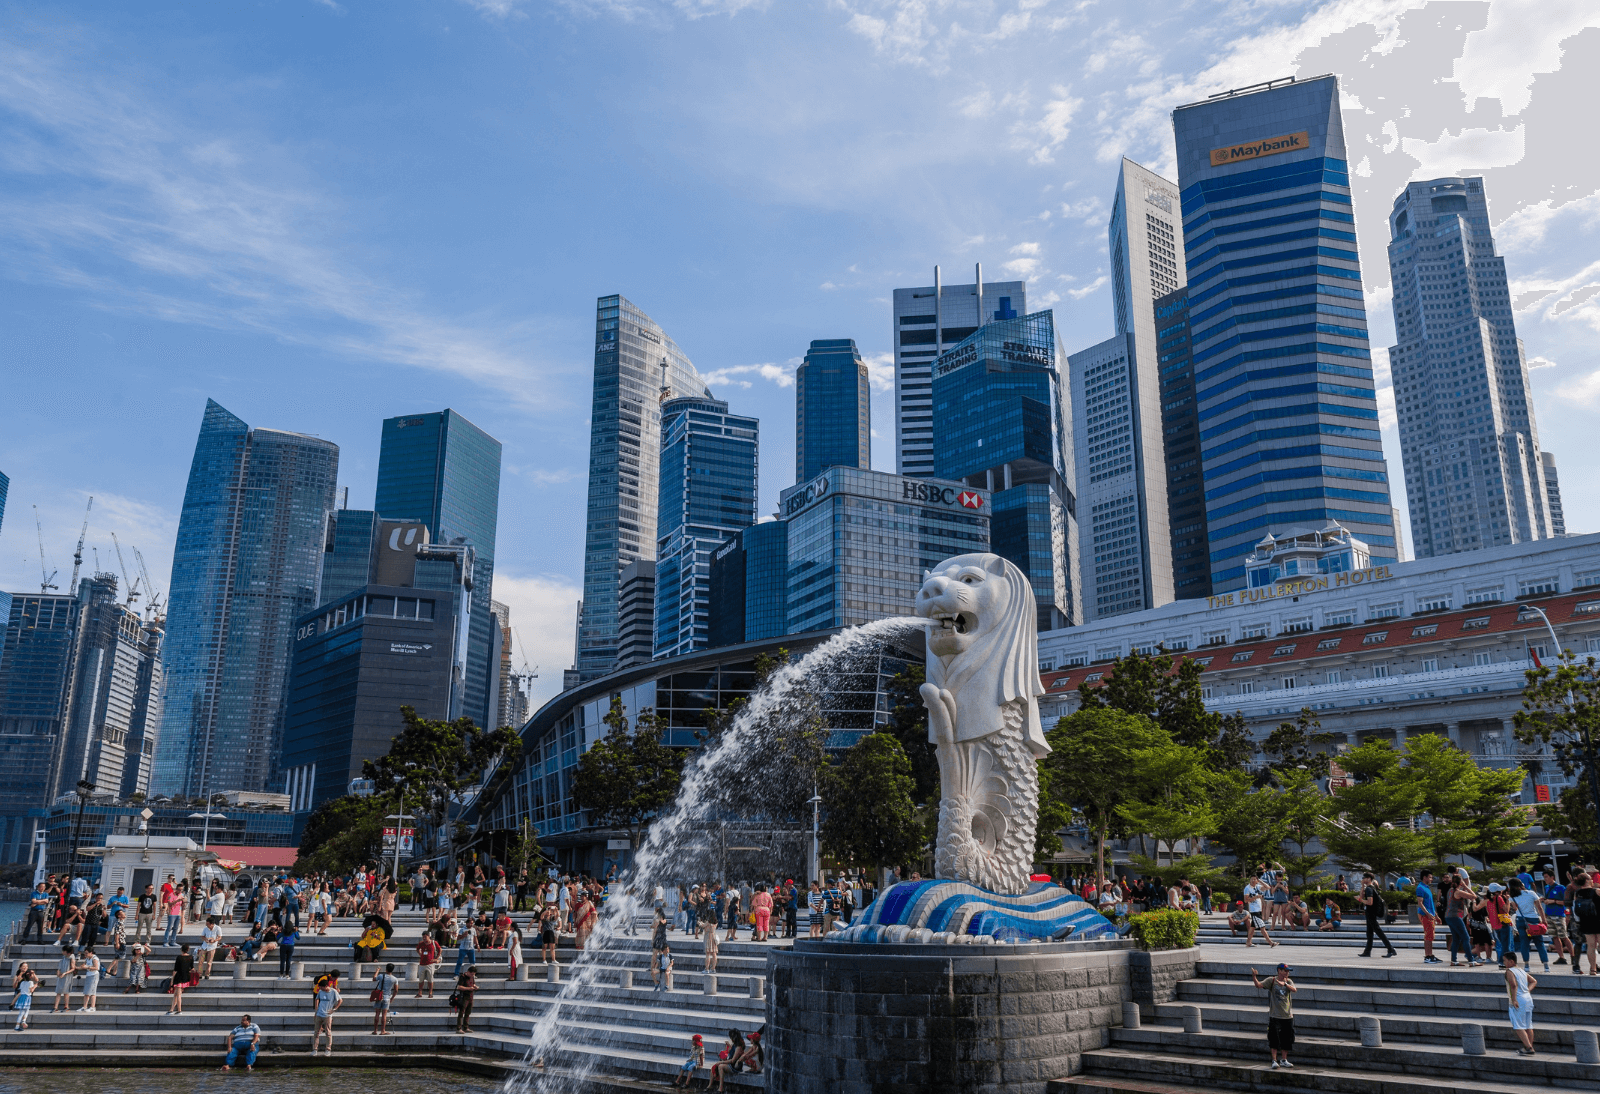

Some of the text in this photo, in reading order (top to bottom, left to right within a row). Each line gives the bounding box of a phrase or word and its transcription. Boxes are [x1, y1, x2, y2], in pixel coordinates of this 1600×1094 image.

[1230, 136, 1299, 159] Maybank
[597, 343, 616, 352] ANZ
[938, 343, 976, 366] STRAITS
[1001, 350, 1048, 366] TRADING
[1003, 341, 1048, 355] STRAITS
[938, 352, 978, 375] TRADING
[785, 485, 814, 516] HSBC
[902, 480, 955, 505] HSBC
[1206, 565, 1394, 609] THE FULLERTON HOTEL
